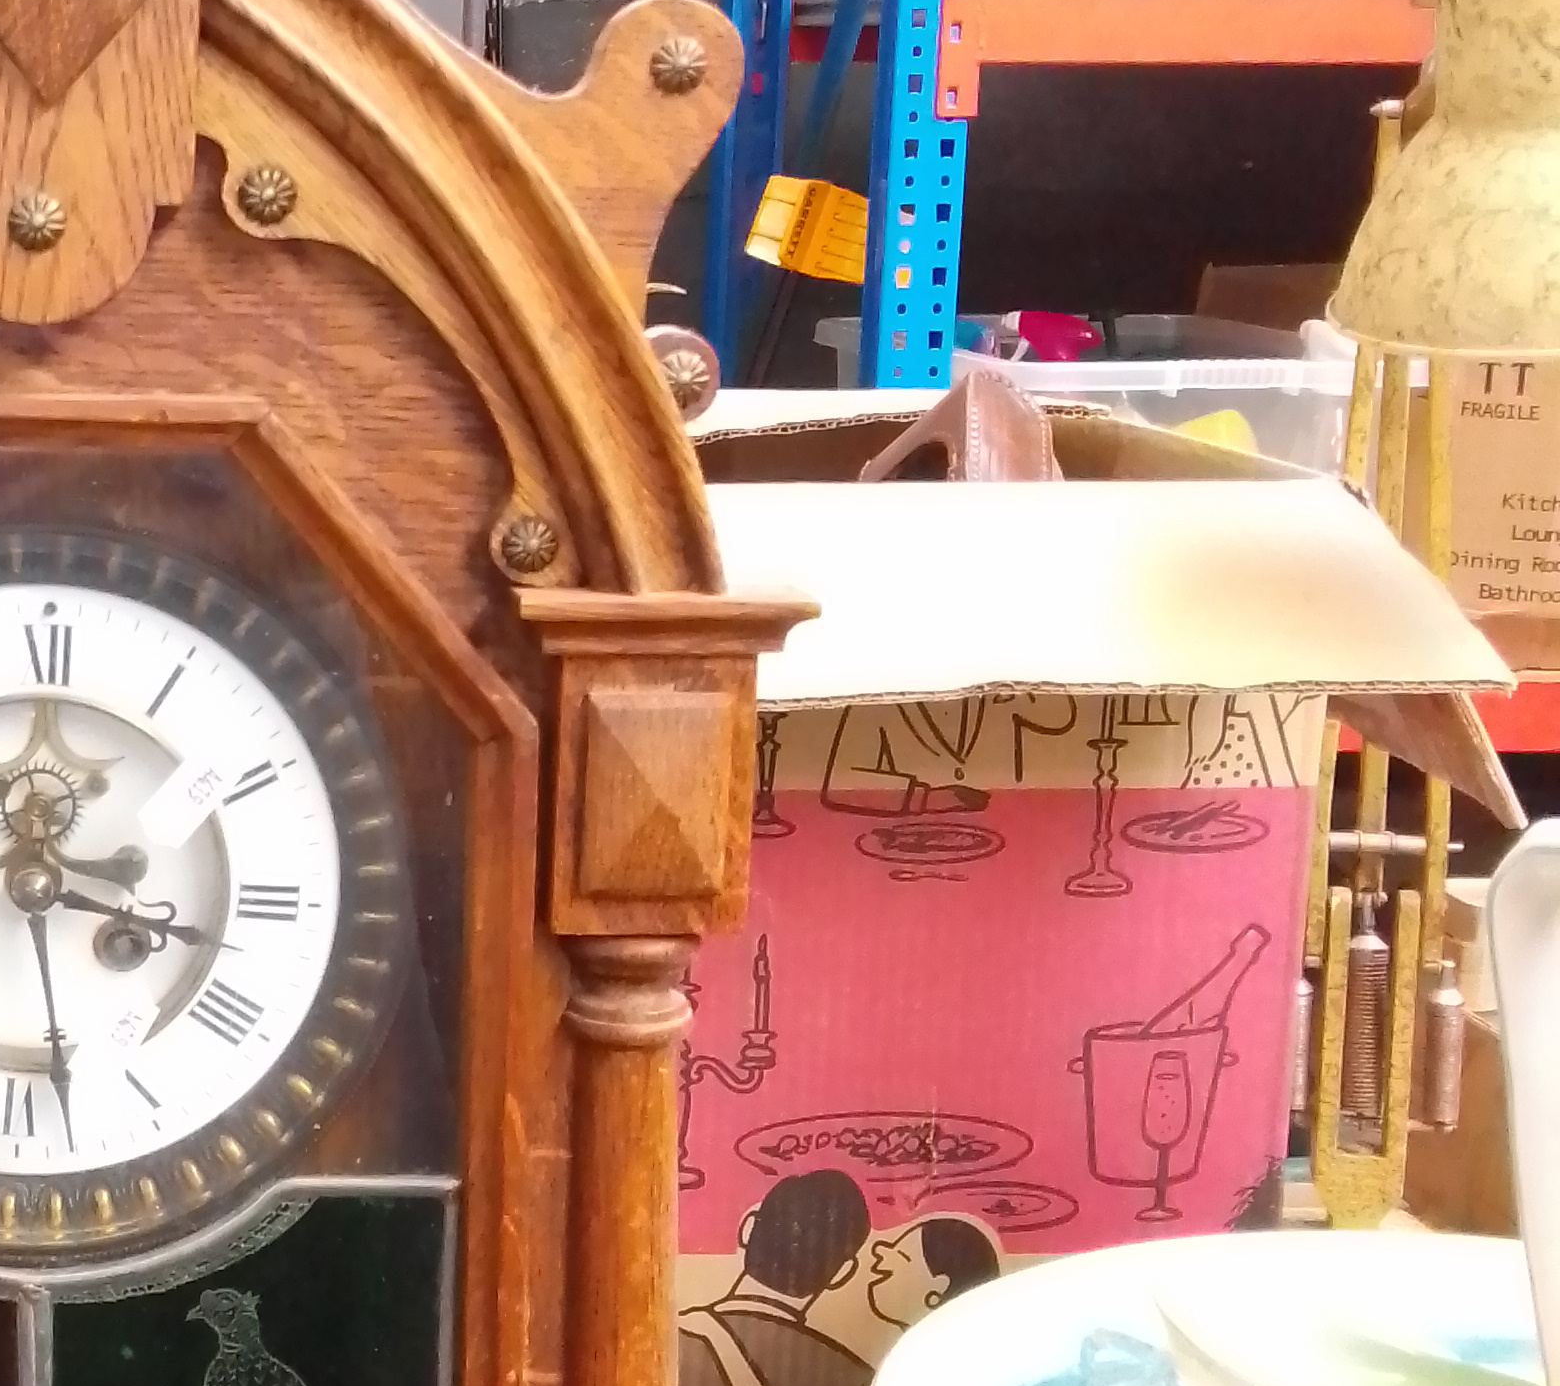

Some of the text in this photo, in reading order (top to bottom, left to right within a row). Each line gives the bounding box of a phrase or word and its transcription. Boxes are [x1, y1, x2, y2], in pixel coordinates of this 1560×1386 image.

[1460, 401, 1540, 420] FRAGILE
[1511, 524, 1560, 546] Loun
[235, 881, 301, 922] III
